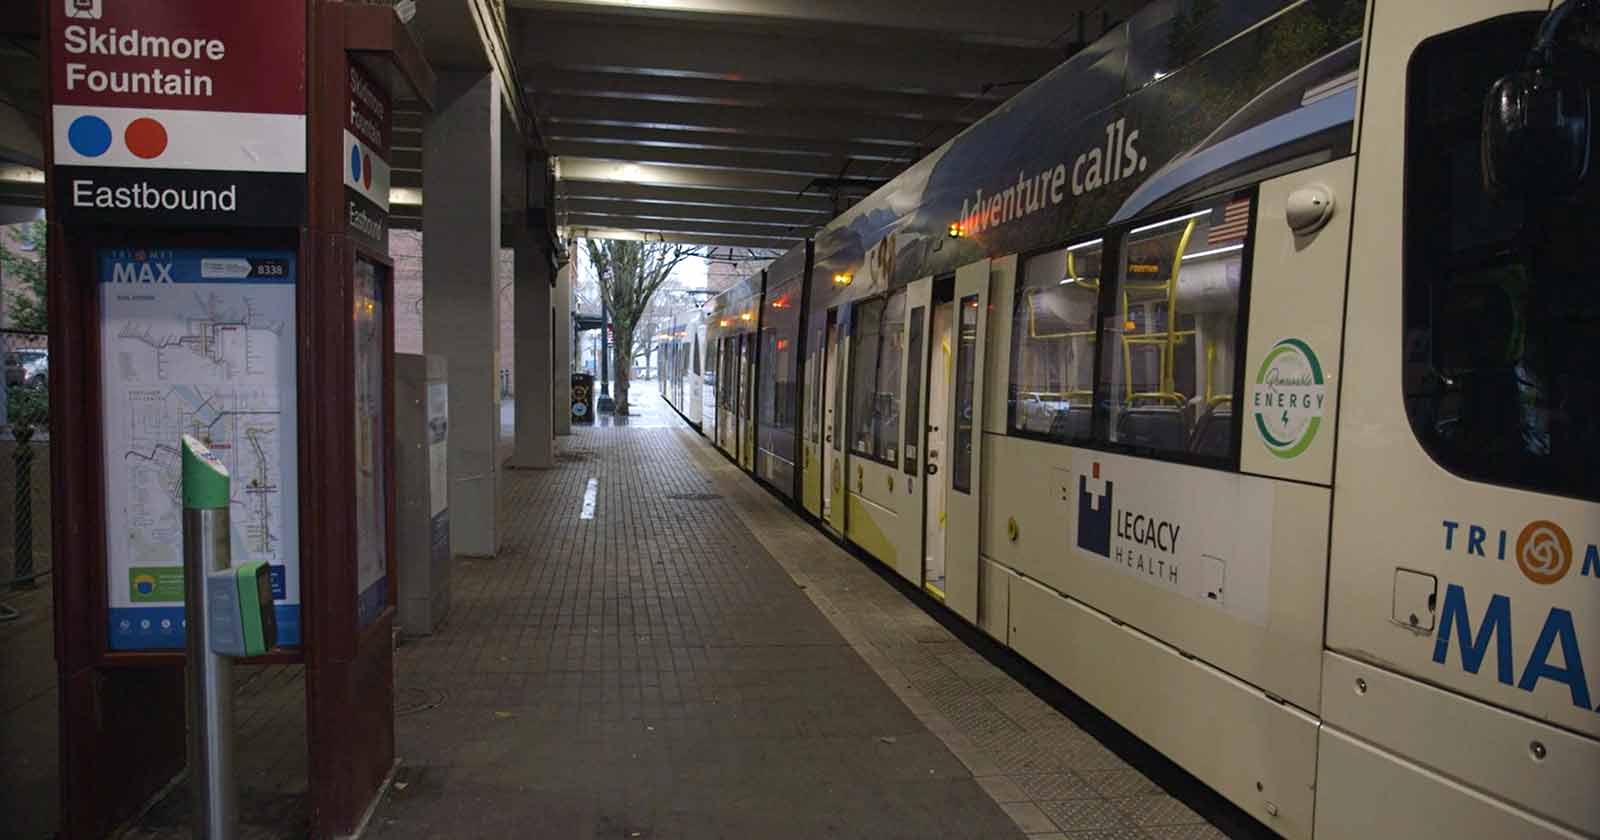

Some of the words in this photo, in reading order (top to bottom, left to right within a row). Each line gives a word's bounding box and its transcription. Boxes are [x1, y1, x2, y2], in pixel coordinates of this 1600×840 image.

[64, 26, 225, 60] Skidmore
[66, 64, 213, 96] Fountain
[960, 163, 1066, 235] Adventure
[1072, 117, 1148, 195] calls.
[72, 180, 237, 211] Eastbound
[111, 263, 174, 284] MAX
[1254, 392, 1324, 408] ENERGY
[1116, 509, 1180, 554] LEGACY
[1442, 520, 1507, 560] TRI
[1115, 546, 1179, 584] HEALTH
[1432, 584, 1600, 714] MA
